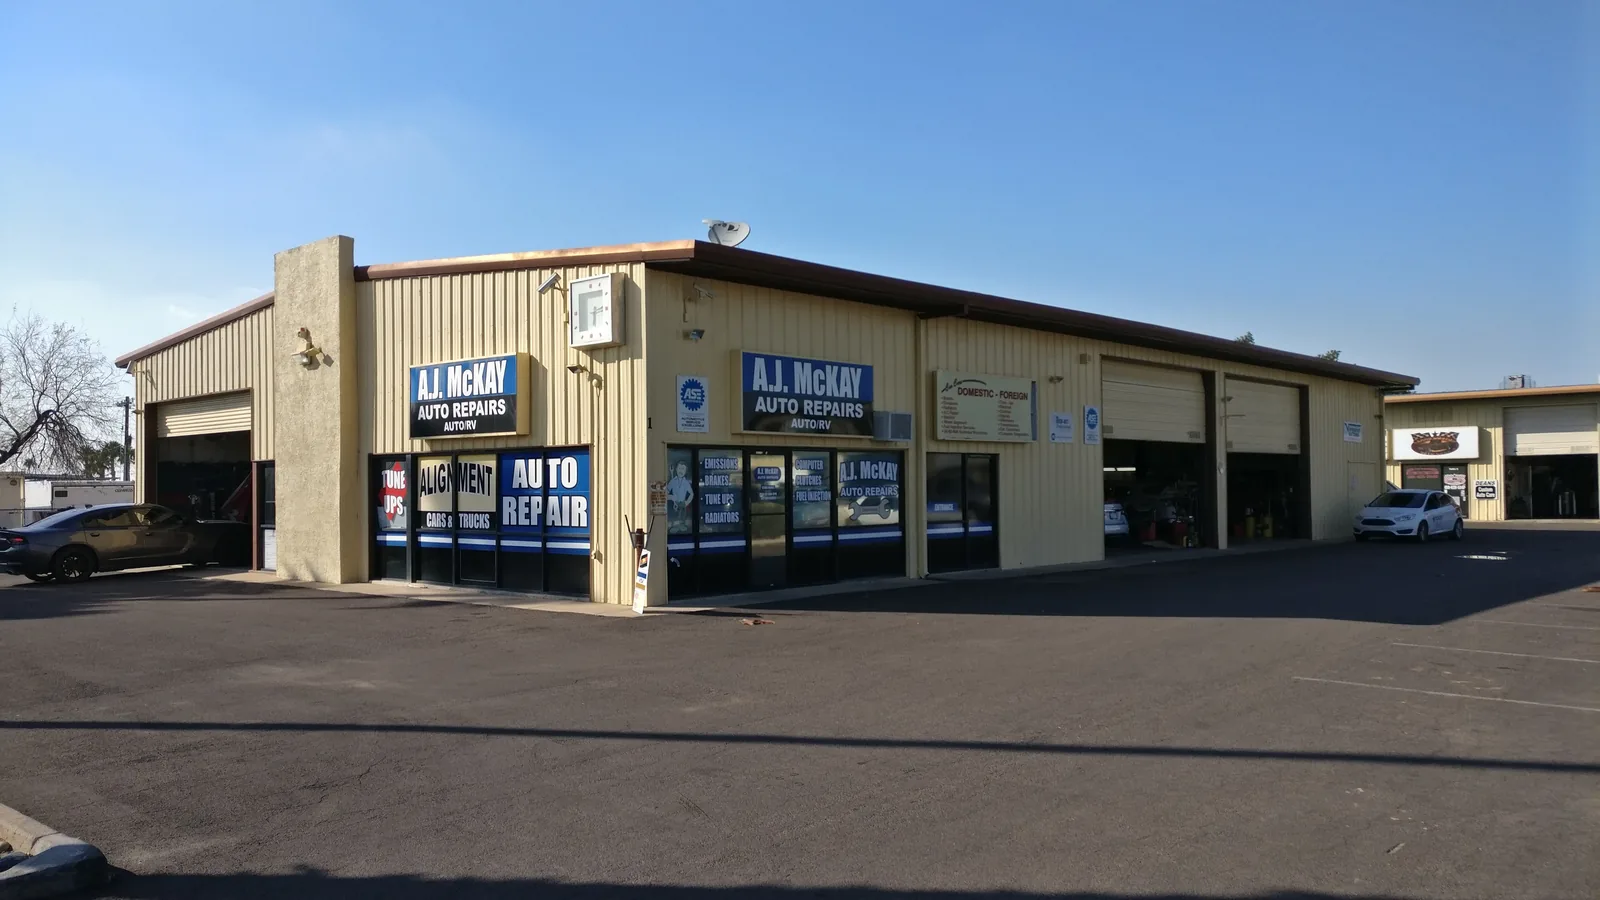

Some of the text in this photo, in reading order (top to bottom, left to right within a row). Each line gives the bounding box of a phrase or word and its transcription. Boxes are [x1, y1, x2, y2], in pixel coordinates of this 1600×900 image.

[418, 360, 507, 400] A.J. McKAY
[753, 357, 862, 398] A.J. McKAY
[683, 388, 702, 400] ASE
[957, 387, 1028, 400] DOMESTIC FOREIGN
[418, 399, 506, 420] AUTO REPAIRS
[755, 397, 864, 418] AUTO REPAIRS
[444, 420, 476, 431] AUTO/RV
[791, 418, 831, 430] AUTO/RV
[704, 458, 738, 469] EMISSIONS
[796, 460, 824, 470] COMPUTER
[512, 456, 578, 488] AUTO
[840, 460, 898, 482] A.J. McKAY
[382, 470, 406, 489] TUNE
[704, 475, 729, 486] BRAKES
[796, 475, 822, 485] CLUTCHES
[796, 491, 807, 501] FUEL
[840, 486, 898, 497] AUTO REPAIRS
[384, 495, 403, 515] UPS
[705, 493, 734, 505] TUNE UPS
[502, 496, 587, 527] REPAIR
[705, 511, 740, 524] RADIATORS
[426, 512, 490, 529] CARS & TRUCKS
